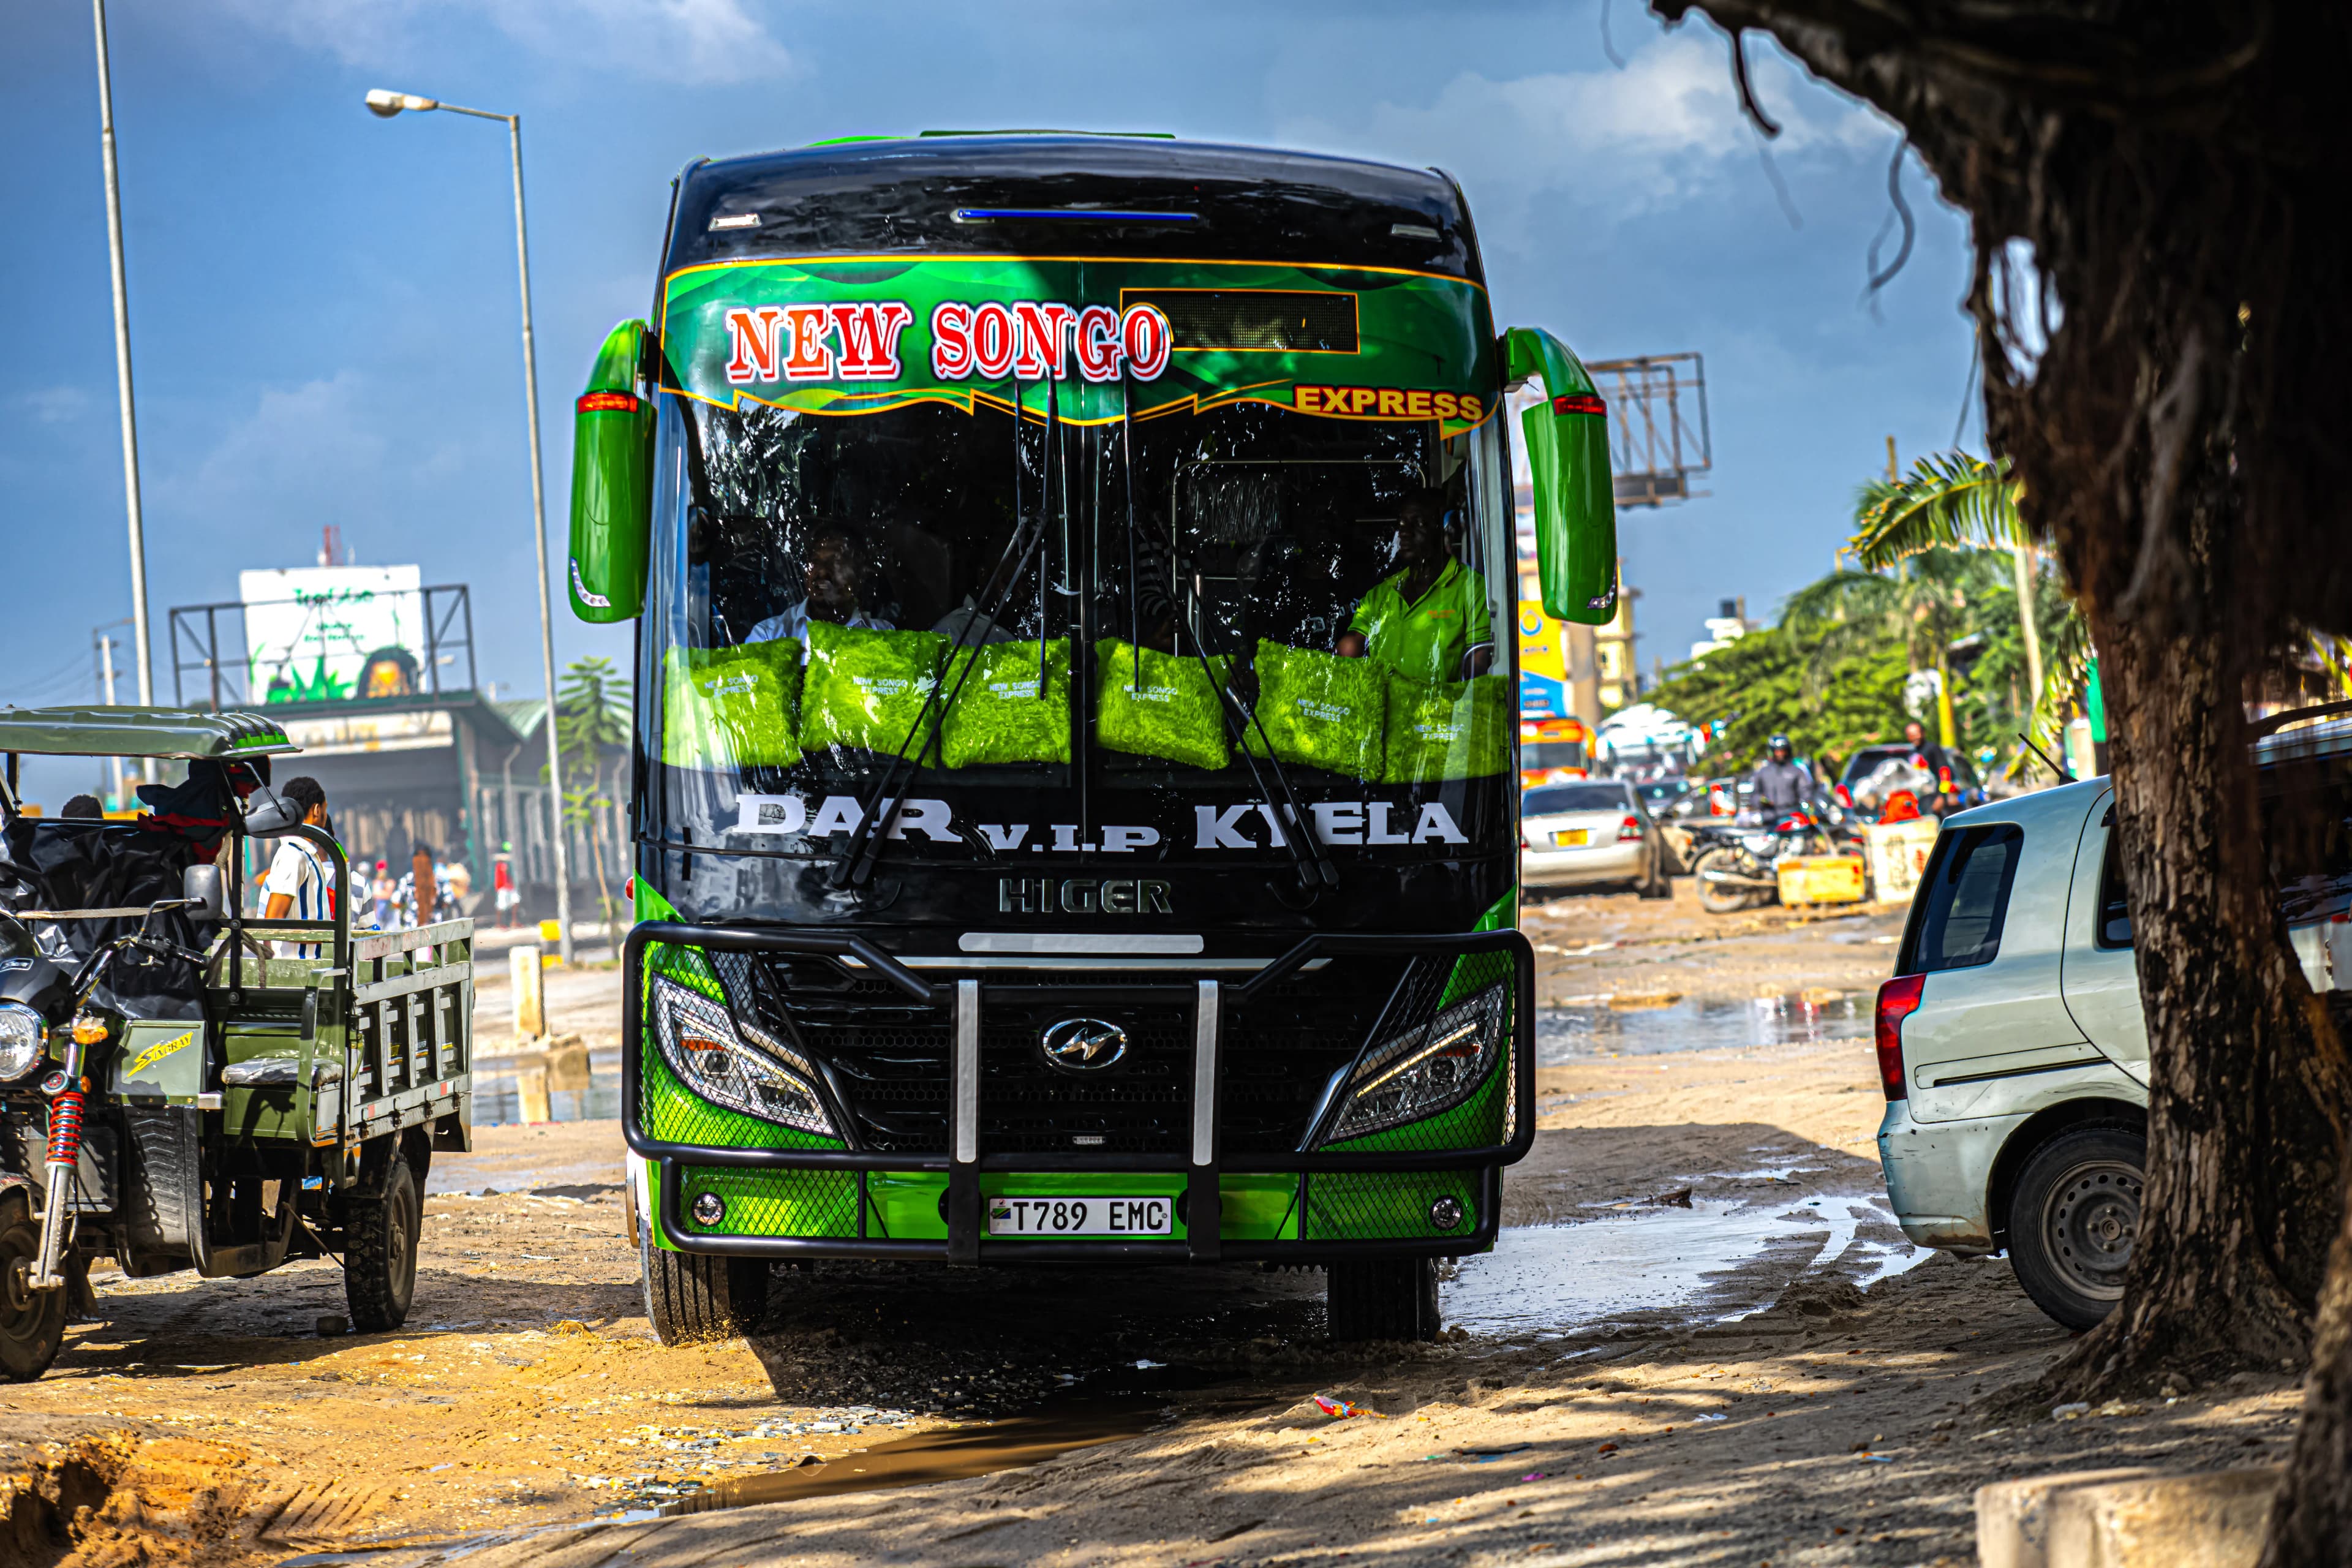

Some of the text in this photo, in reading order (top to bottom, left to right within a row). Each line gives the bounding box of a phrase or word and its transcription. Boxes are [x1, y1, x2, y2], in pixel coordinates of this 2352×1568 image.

[725, 301, 1173, 384] NEW SONGO
[1294, 385, 1483, 421] EXPRESS
[853, 676, 908, 687] NEW SONGO
[989, 682, 1008, 692] NEW
[861, 685, 899, 695] EXPRESS
[998, 690, 1035, 699] EXPRESS
[1147, 686, 1177, 695] SONGO
[1131, 693, 1169, 703] EXPRESS
[1297, 698, 1350, 715] NEW SONGO
[1303, 708, 1340, 722] EXPRESS
[732, 794, 963, 843] DAR
[978, 824, 1160, 852] V.I.P
[1000, 878, 1173, 913] HIGER
[1012, 1201, 1163, 1231] T789 EMC
